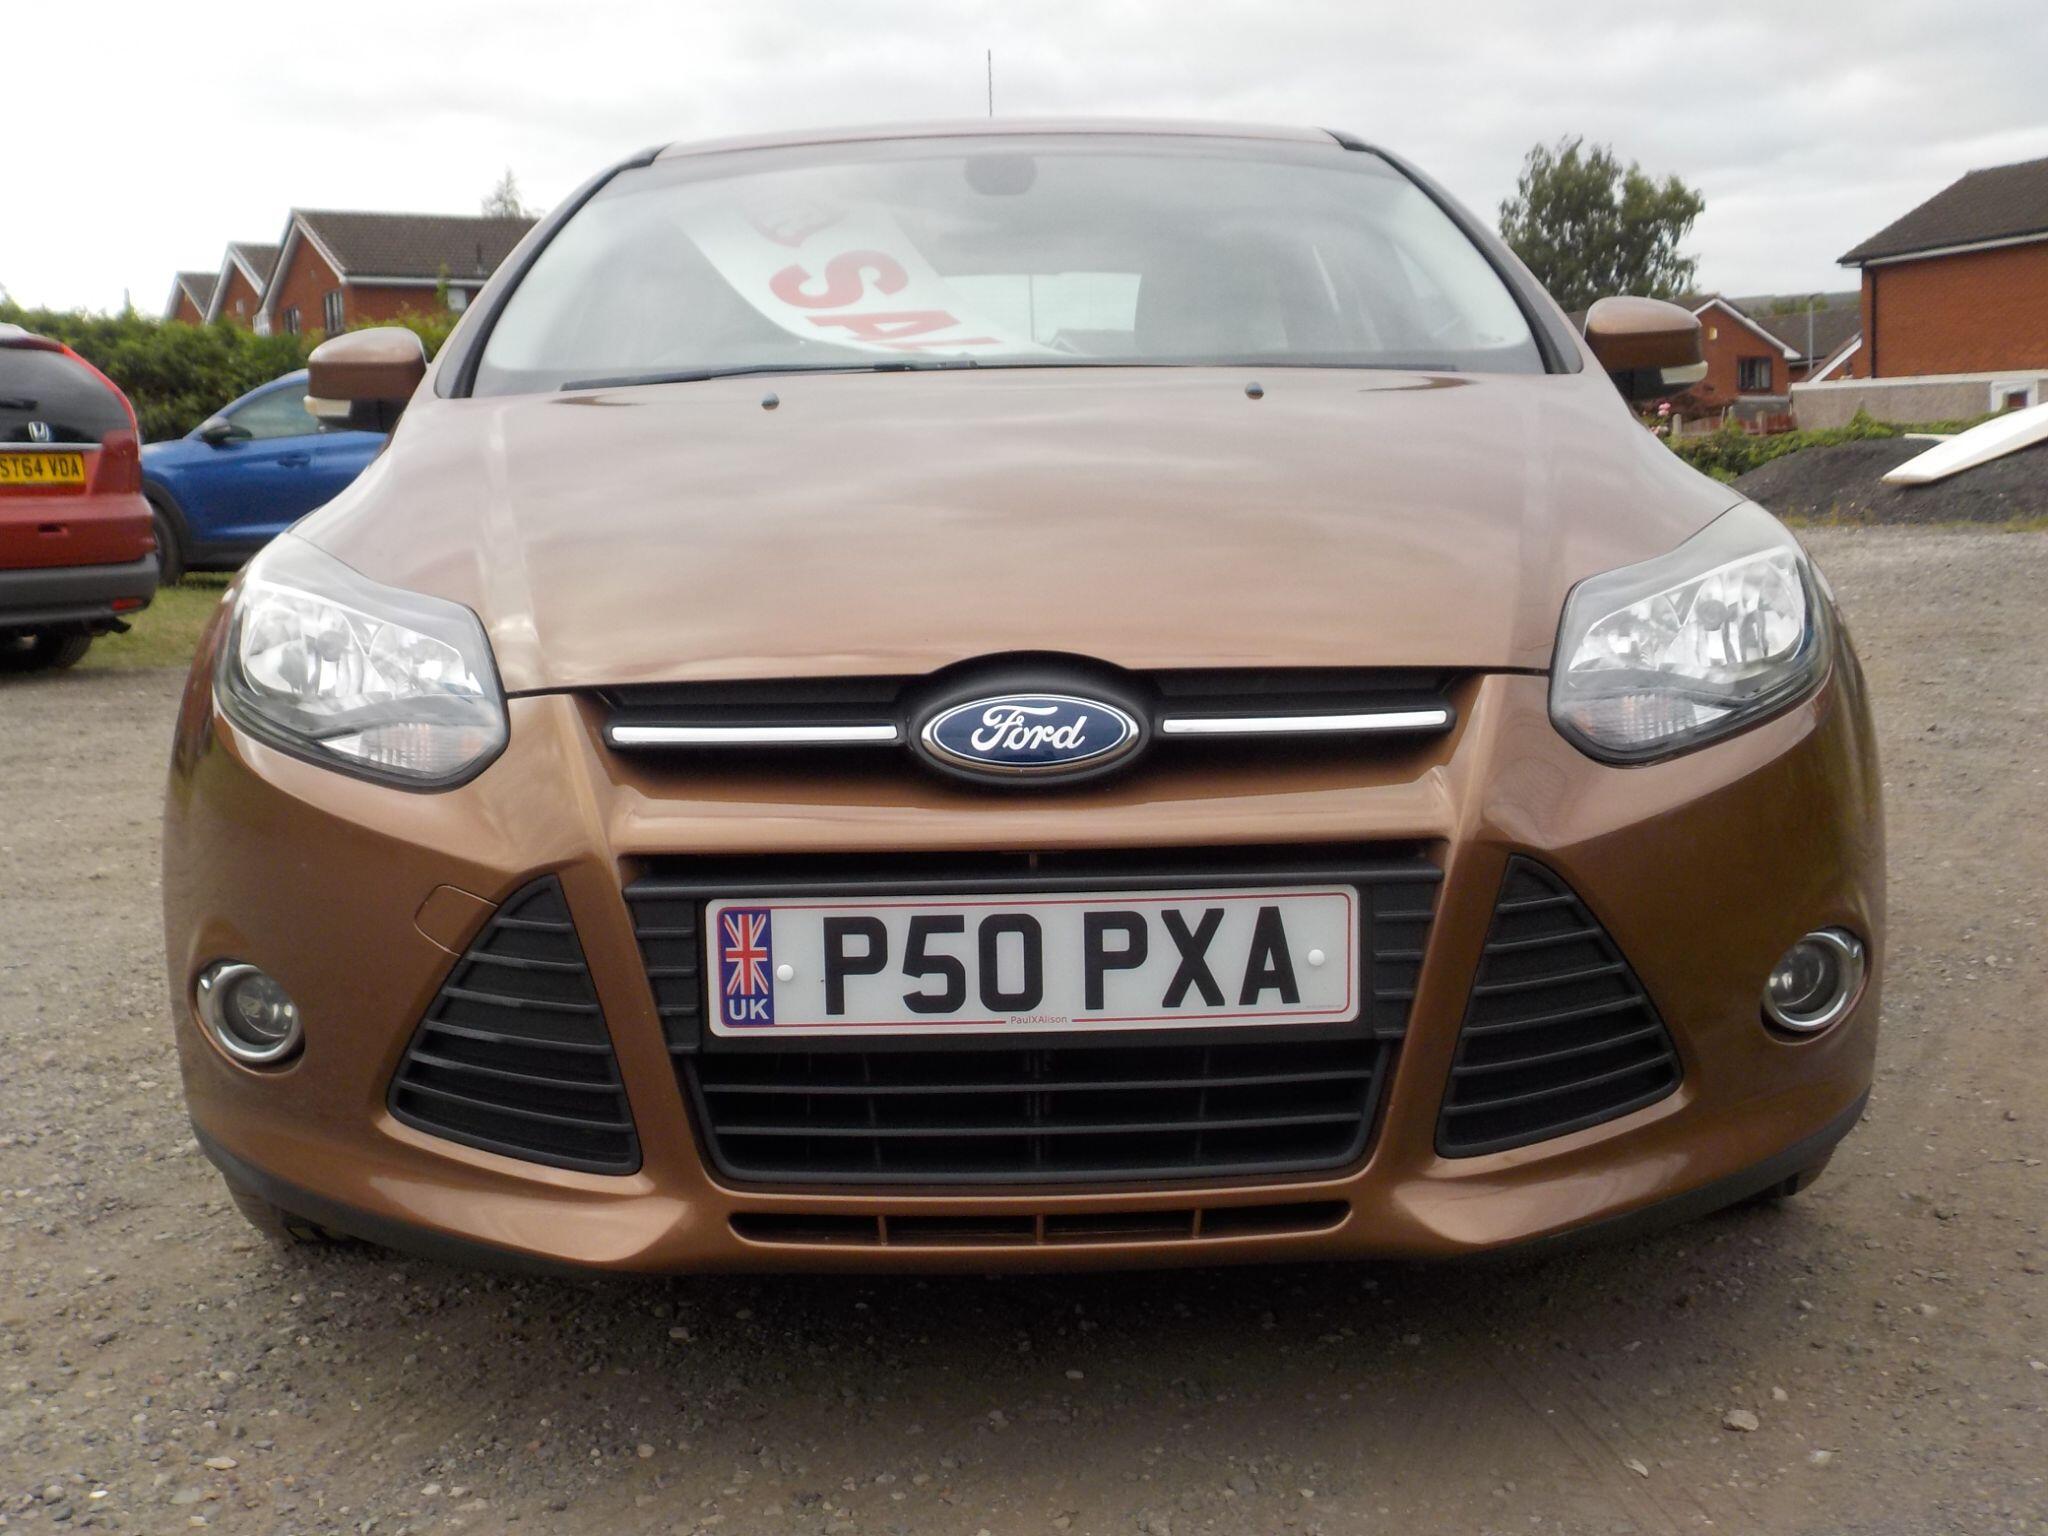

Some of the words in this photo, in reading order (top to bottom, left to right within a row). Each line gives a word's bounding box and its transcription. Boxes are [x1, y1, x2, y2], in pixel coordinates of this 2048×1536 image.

[971, 705, 1086, 751] Ford
[823, 913, 1044, 1015] P50
[1084, 906, 1301, 1010] PXA
[729, 998, 770, 1021] UK
